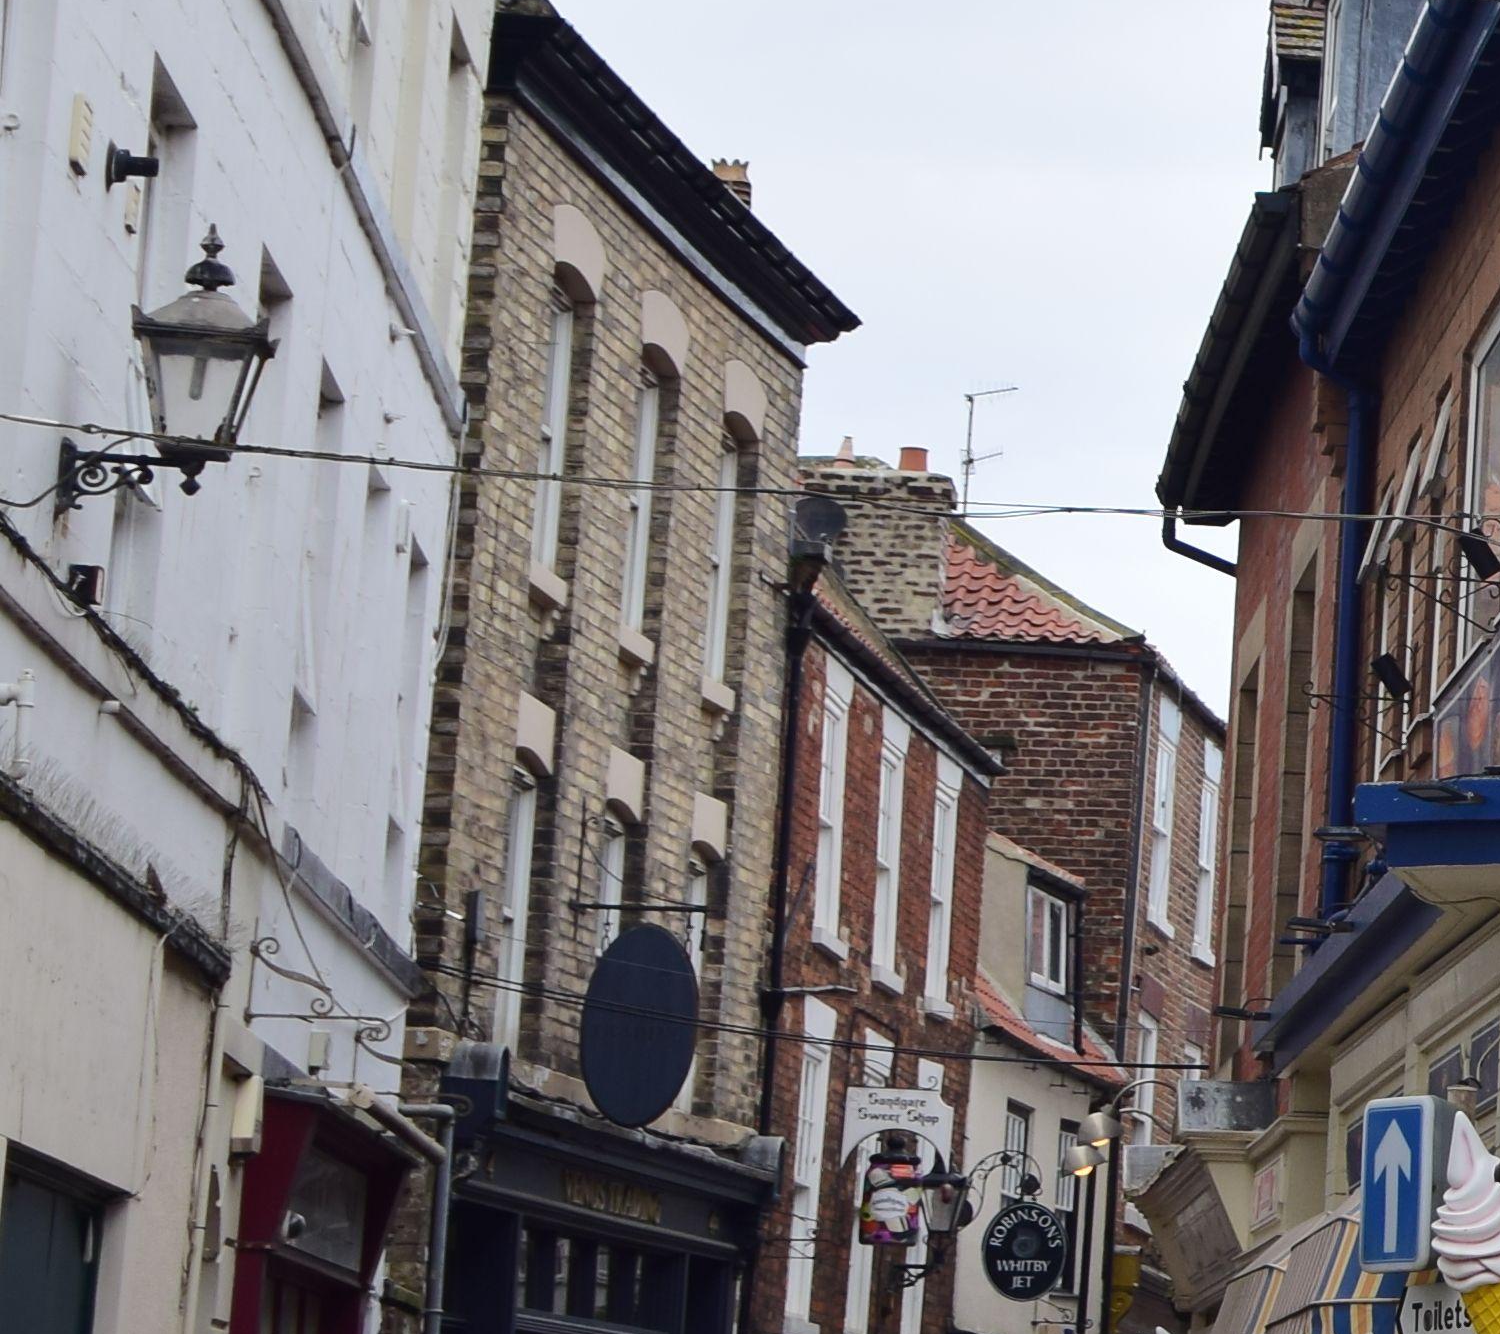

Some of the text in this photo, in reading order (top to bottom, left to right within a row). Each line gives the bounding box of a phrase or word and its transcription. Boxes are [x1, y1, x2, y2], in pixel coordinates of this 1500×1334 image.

[907, 1108, 940, 1127] Shop
[996, 1259, 1052, 1273] WHITBY
[1009, 1275, 1036, 1290] JET
[1412, 1299, 1472, 1333] Toilets
